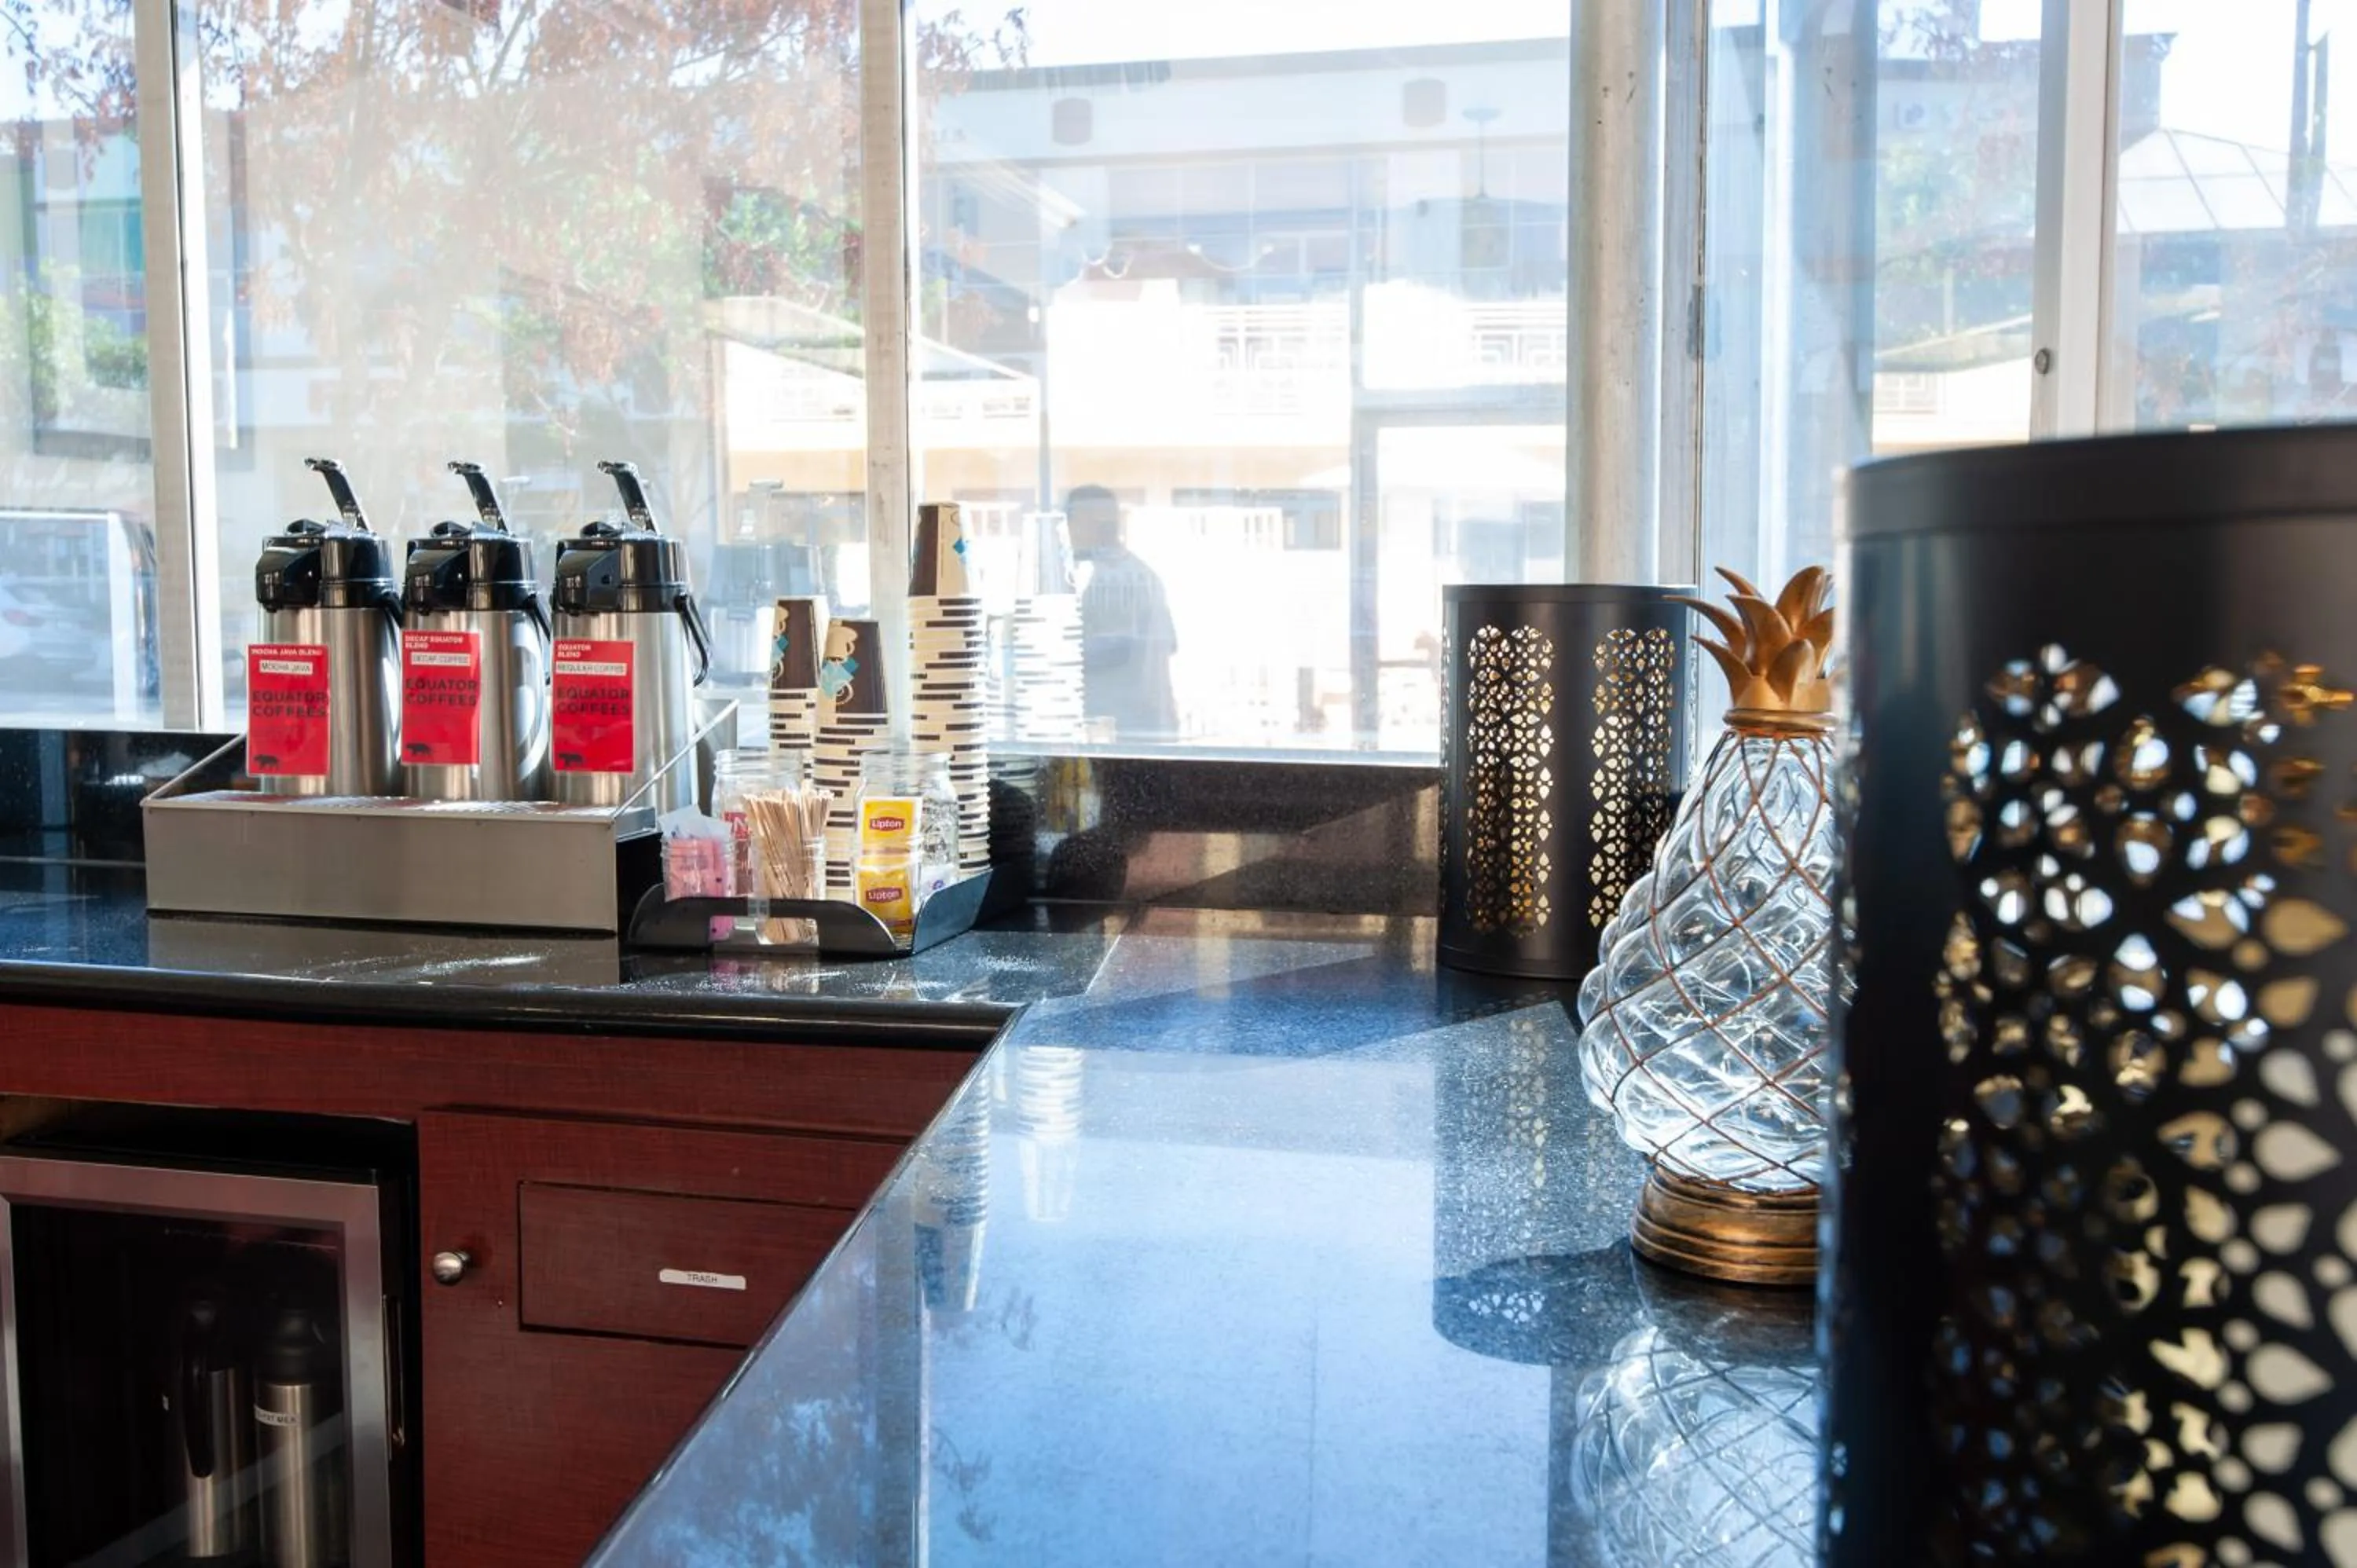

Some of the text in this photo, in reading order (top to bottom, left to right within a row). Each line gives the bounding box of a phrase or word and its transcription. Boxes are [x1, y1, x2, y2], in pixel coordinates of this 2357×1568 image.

[405, 678, 477, 690] EQUATOR
[252, 691, 328, 703] EQUATOR
[405, 693, 476, 705] COFFEES
[557, 687, 629, 699] EQUATOR
[252, 705, 328, 716] COFFEES
[557, 702, 629, 715] COFFEES
[871, 819, 902, 830] Lipton
[868, 888, 900, 900] Lipton
[687, 1273, 717, 1283] TRASH
